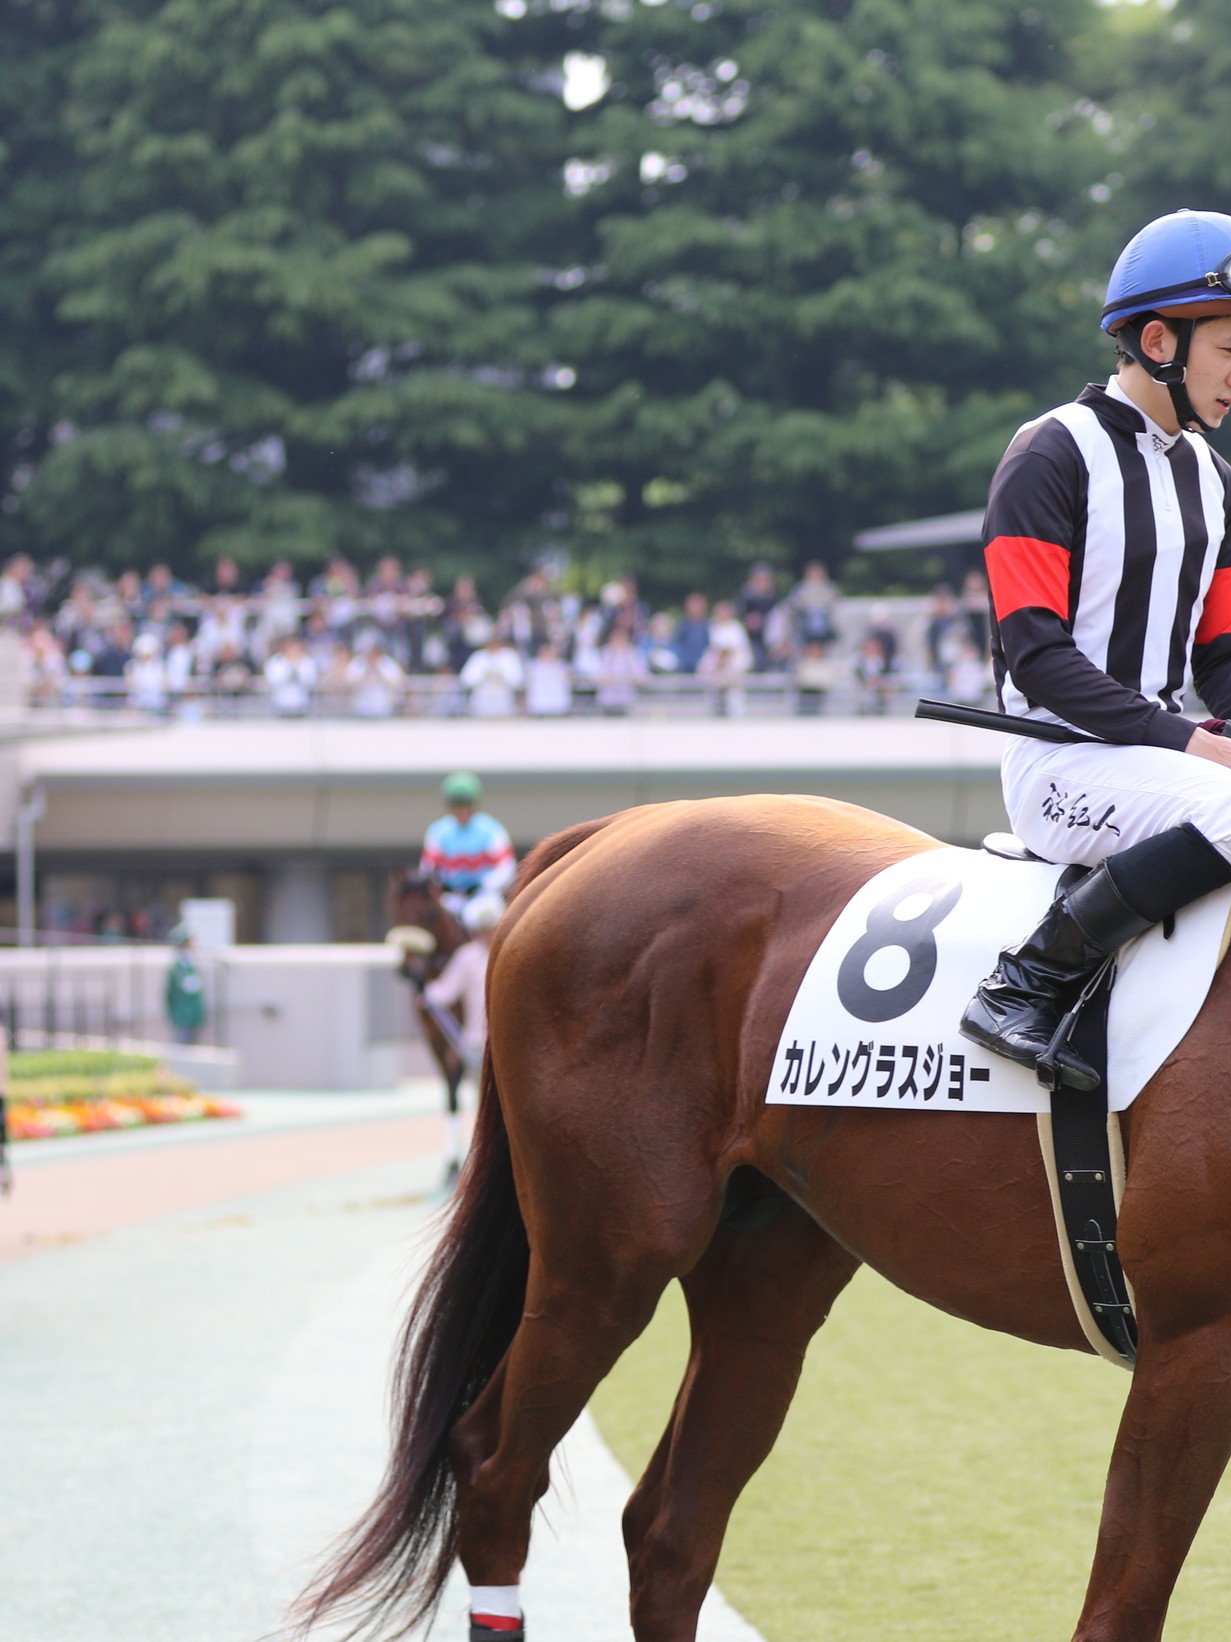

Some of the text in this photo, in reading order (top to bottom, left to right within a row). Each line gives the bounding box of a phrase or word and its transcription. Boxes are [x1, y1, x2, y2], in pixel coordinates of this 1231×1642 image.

[837, 876, 963, 1023] 8
[780, 1040, 991, 1101] カレングラスジョー
